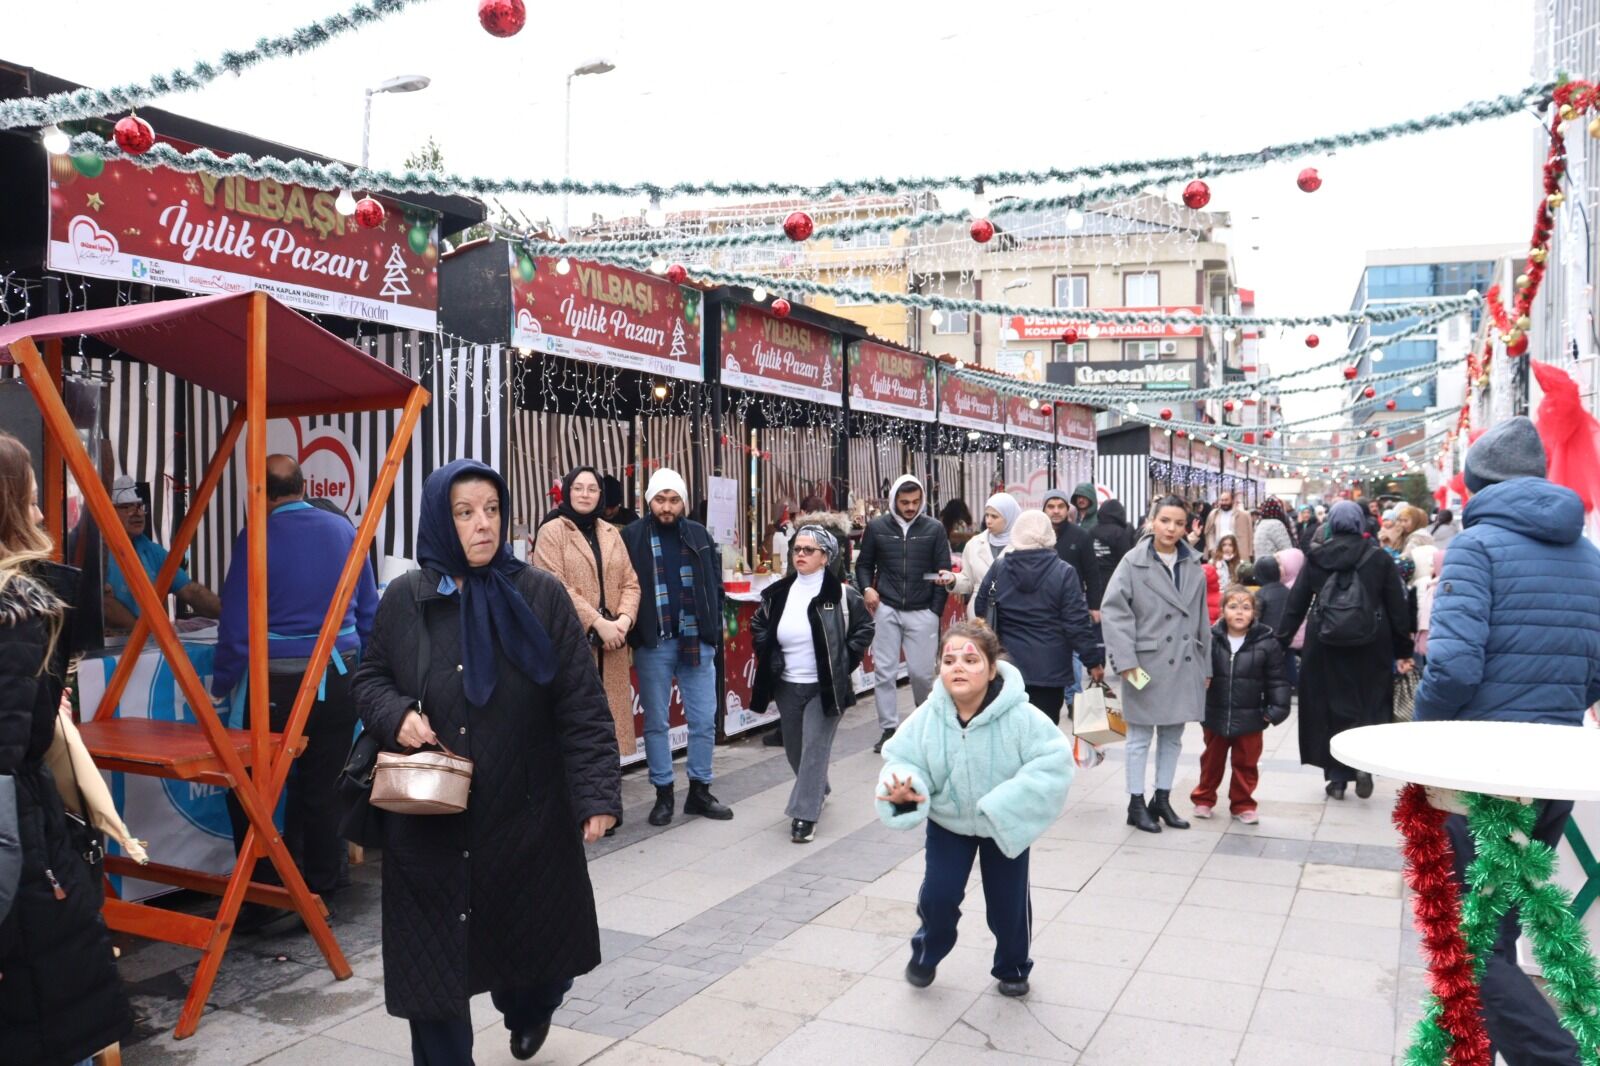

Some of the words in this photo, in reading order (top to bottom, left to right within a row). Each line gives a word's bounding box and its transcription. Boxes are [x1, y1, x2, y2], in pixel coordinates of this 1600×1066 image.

[199, 171, 346, 240] YILBAŞI
[159, 200, 256, 262] İyilik
[261, 228, 370, 281] Pazarı
[254, 282, 275, 293] FATMA
[276, 286, 301, 297] KAPLAN
[302, 291, 330, 302] HÜRRİYET
[576, 264, 653, 317] YILBAŞI
[559, 293, 607, 338] İyilik
[610, 310, 666, 347] Pazarı
[762, 316, 811, 356] YILBAŞI
[1092, 322, 1165, 336] AŞKANLIĞI
[752, 340, 782, 375] İyilik
[783, 351, 819, 379] Pazarı
[1077, 364, 1191, 383] GreenMed
